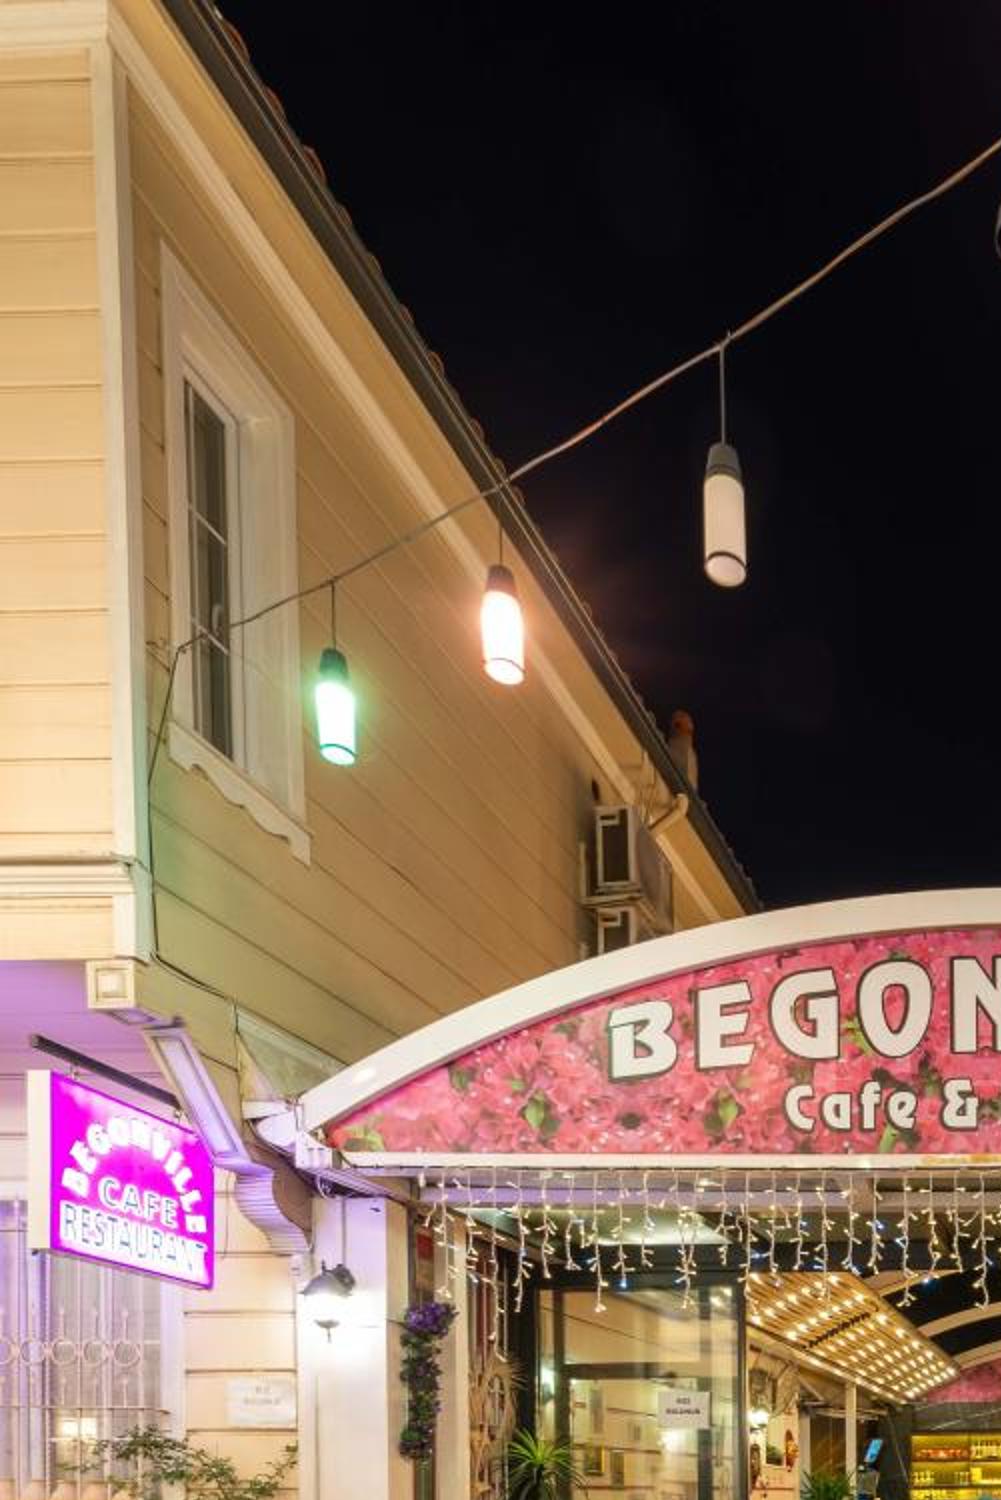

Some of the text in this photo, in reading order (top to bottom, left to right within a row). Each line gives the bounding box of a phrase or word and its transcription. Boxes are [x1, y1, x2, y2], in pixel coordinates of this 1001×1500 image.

[785, 1081, 919, 1132] Cafe
[941, 1078, 979, 1131] &
[98, 1178, 179, 1230] CAFE
[60, 1202, 209, 1274] RESTAURANT
